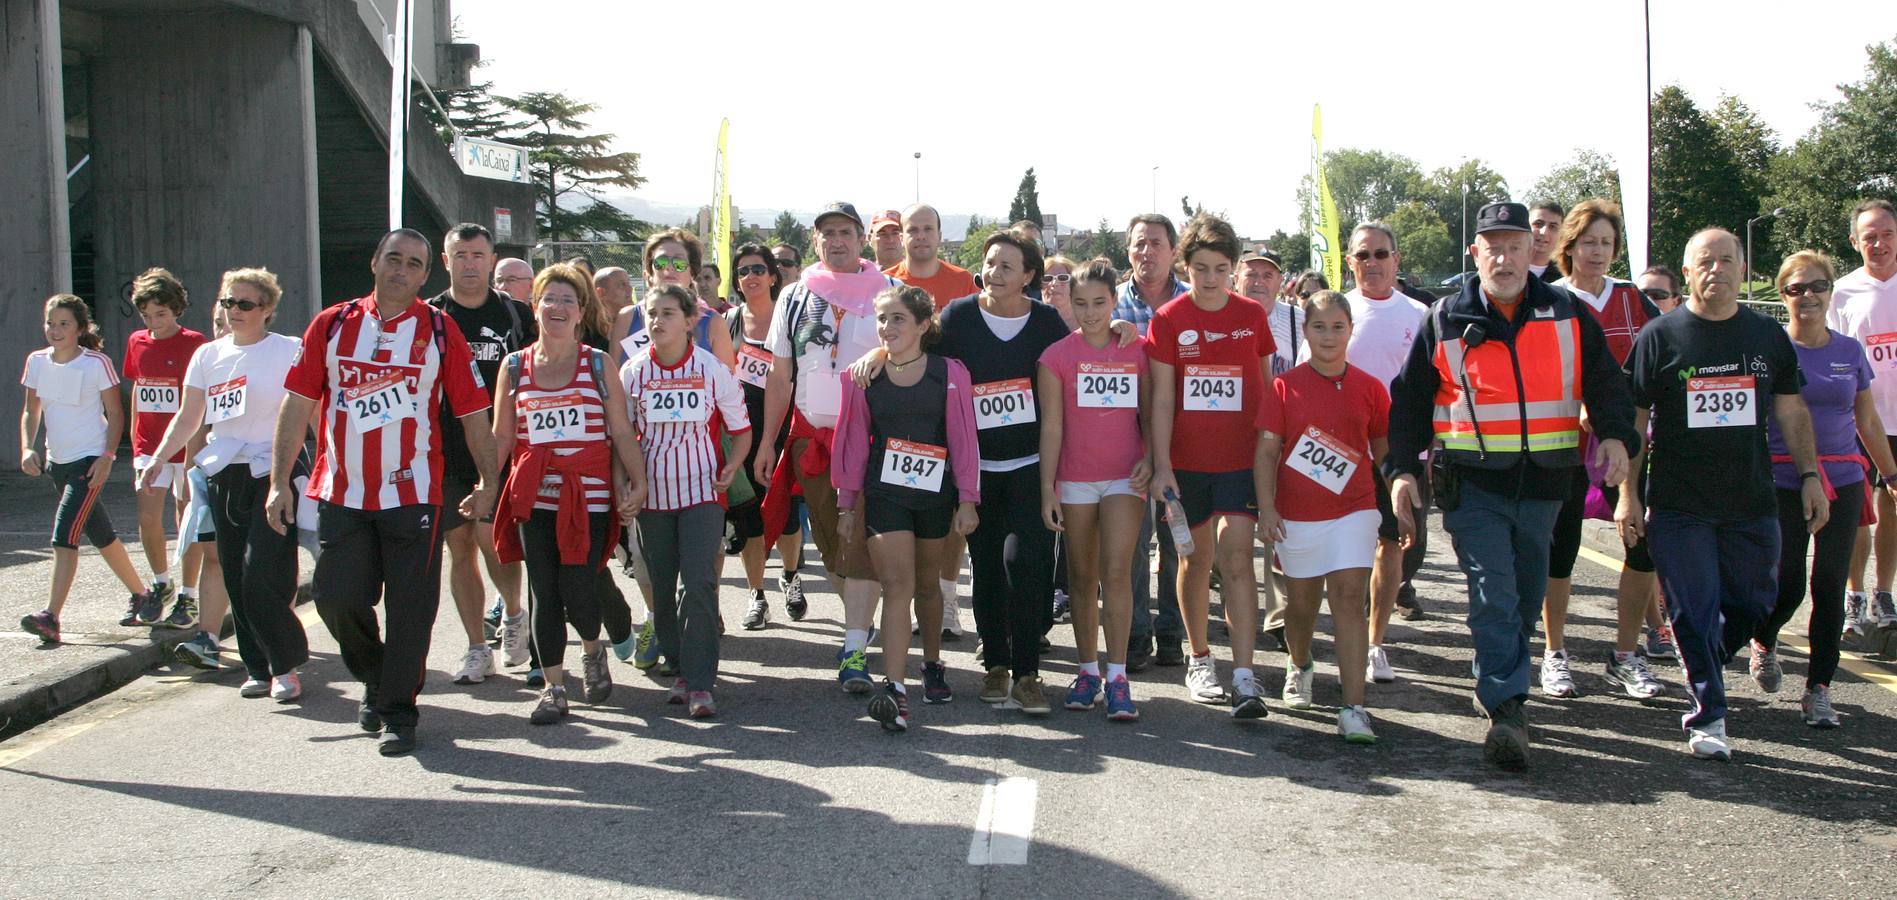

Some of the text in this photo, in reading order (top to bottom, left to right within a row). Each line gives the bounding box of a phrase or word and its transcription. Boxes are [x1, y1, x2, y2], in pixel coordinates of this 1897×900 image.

[1698, 363, 1740, 374] movistar
[140, 388, 174, 403] 0010
[1083, 376, 1130, 395] 2045
[1190, 379, 1235, 398] 2043
[213, 390, 242, 412] 1450
[355, 387, 402, 419] 2611
[652, 391, 699, 410] 2610
[980, 393, 1025, 416] 0001
[1694, 391, 1748, 413] 2389
[533, 408, 579, 431] 2612
[892, 454, 939, 477] 1847
[1298, 440, 1348, 479] 2044
